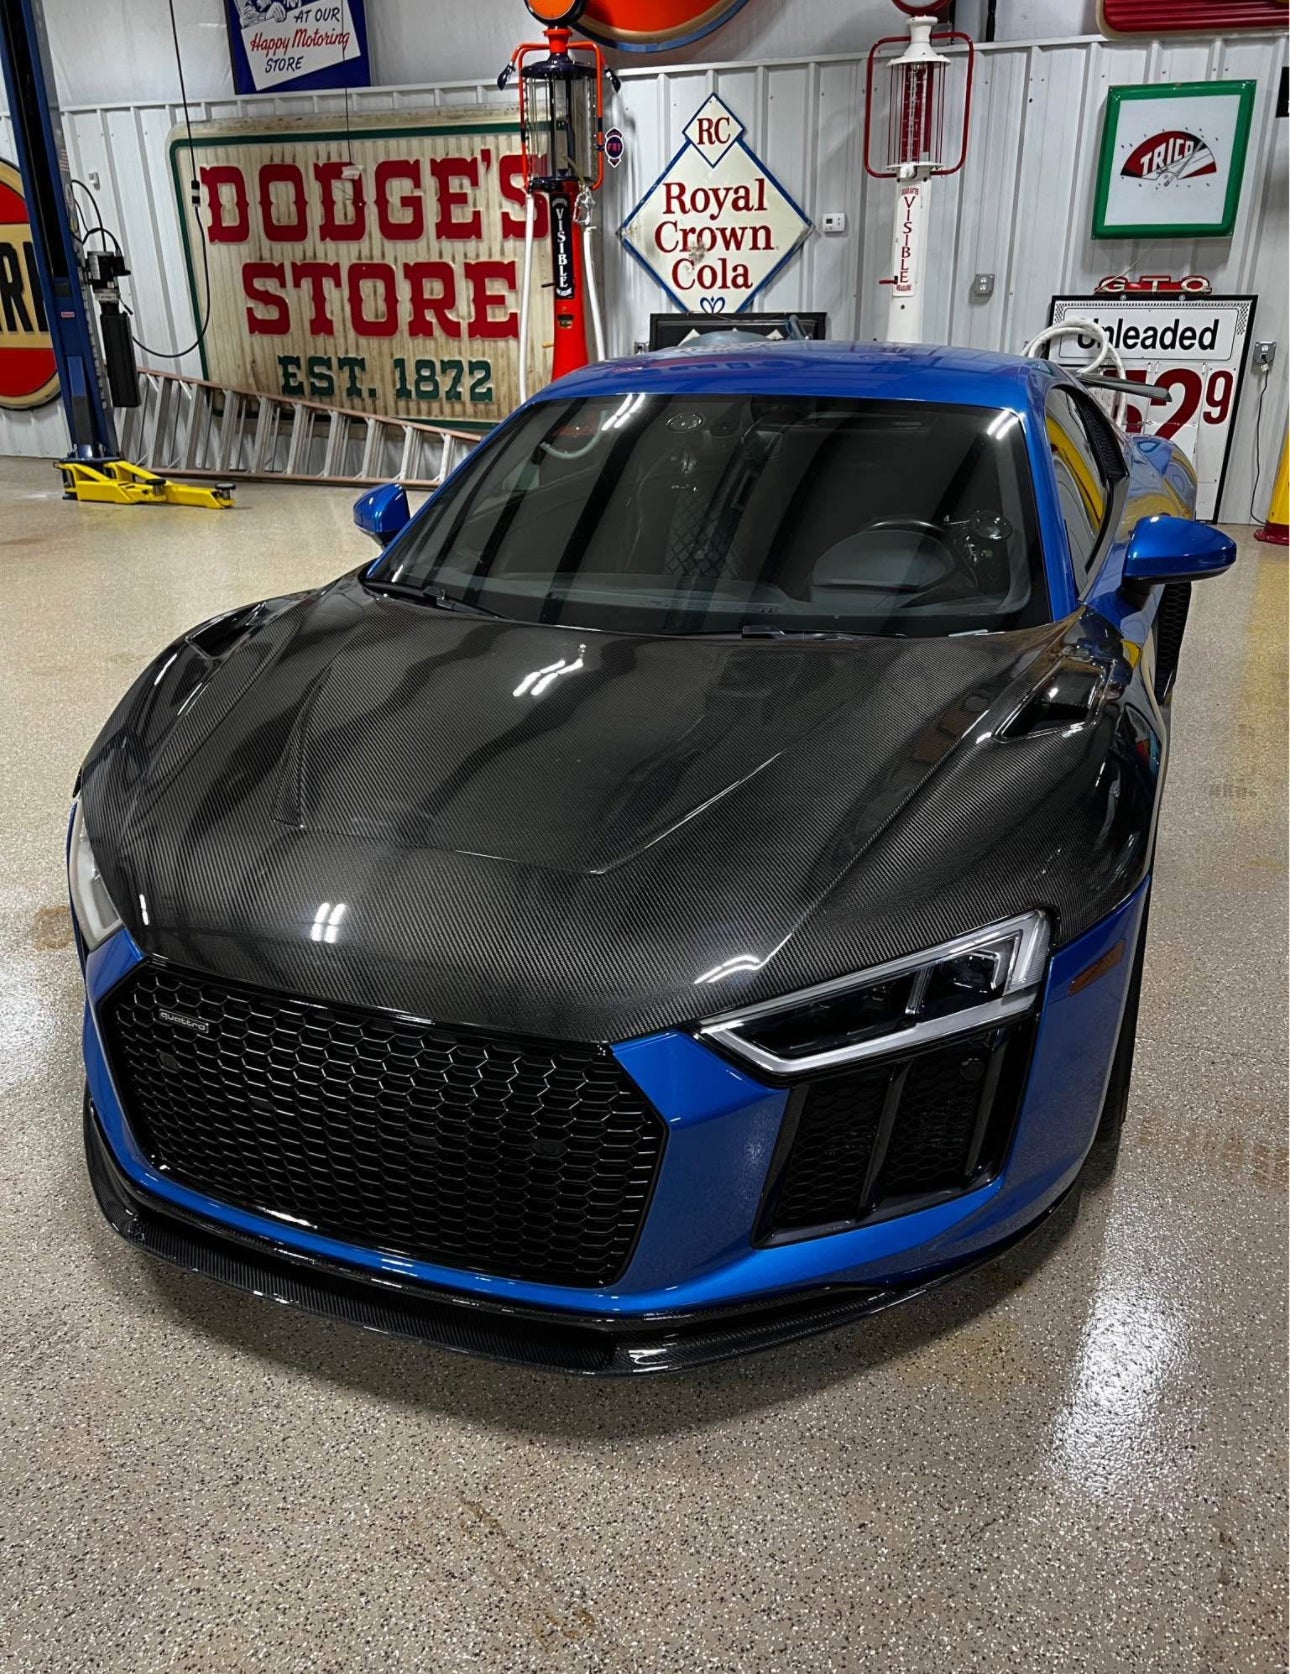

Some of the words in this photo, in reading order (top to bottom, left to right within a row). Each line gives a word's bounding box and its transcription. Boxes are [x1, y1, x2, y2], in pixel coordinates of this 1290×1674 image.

[294, 9, 312, 24] AT
[315, 7, 340, 22] OUR
[250, 32, 290, 57] Happy
[292, 28, 350, 53] Motoring
[265, 56, 304, 73] STORE
[697, 117, 731, 145] RC
[1140, 138, 1195, 177] TRICO
[200, 149, 549, 243] DODGE'S
[662, 178, 768, 221] Royal
[555, 208, 569, 288] VISIBLE
[654, 221, 775, 254] Crown
[900, 196, 915, 283] VISIBLE
[672, 257, 754, 290] Cola
[1099, 277, 1212, 293] GTO
[242, 261, 520, 339] STORE
[278, 355, 377, 398] EST.
[394, 356, 493, 402] 1872
[160, 1012, 206, 1031] quattro
